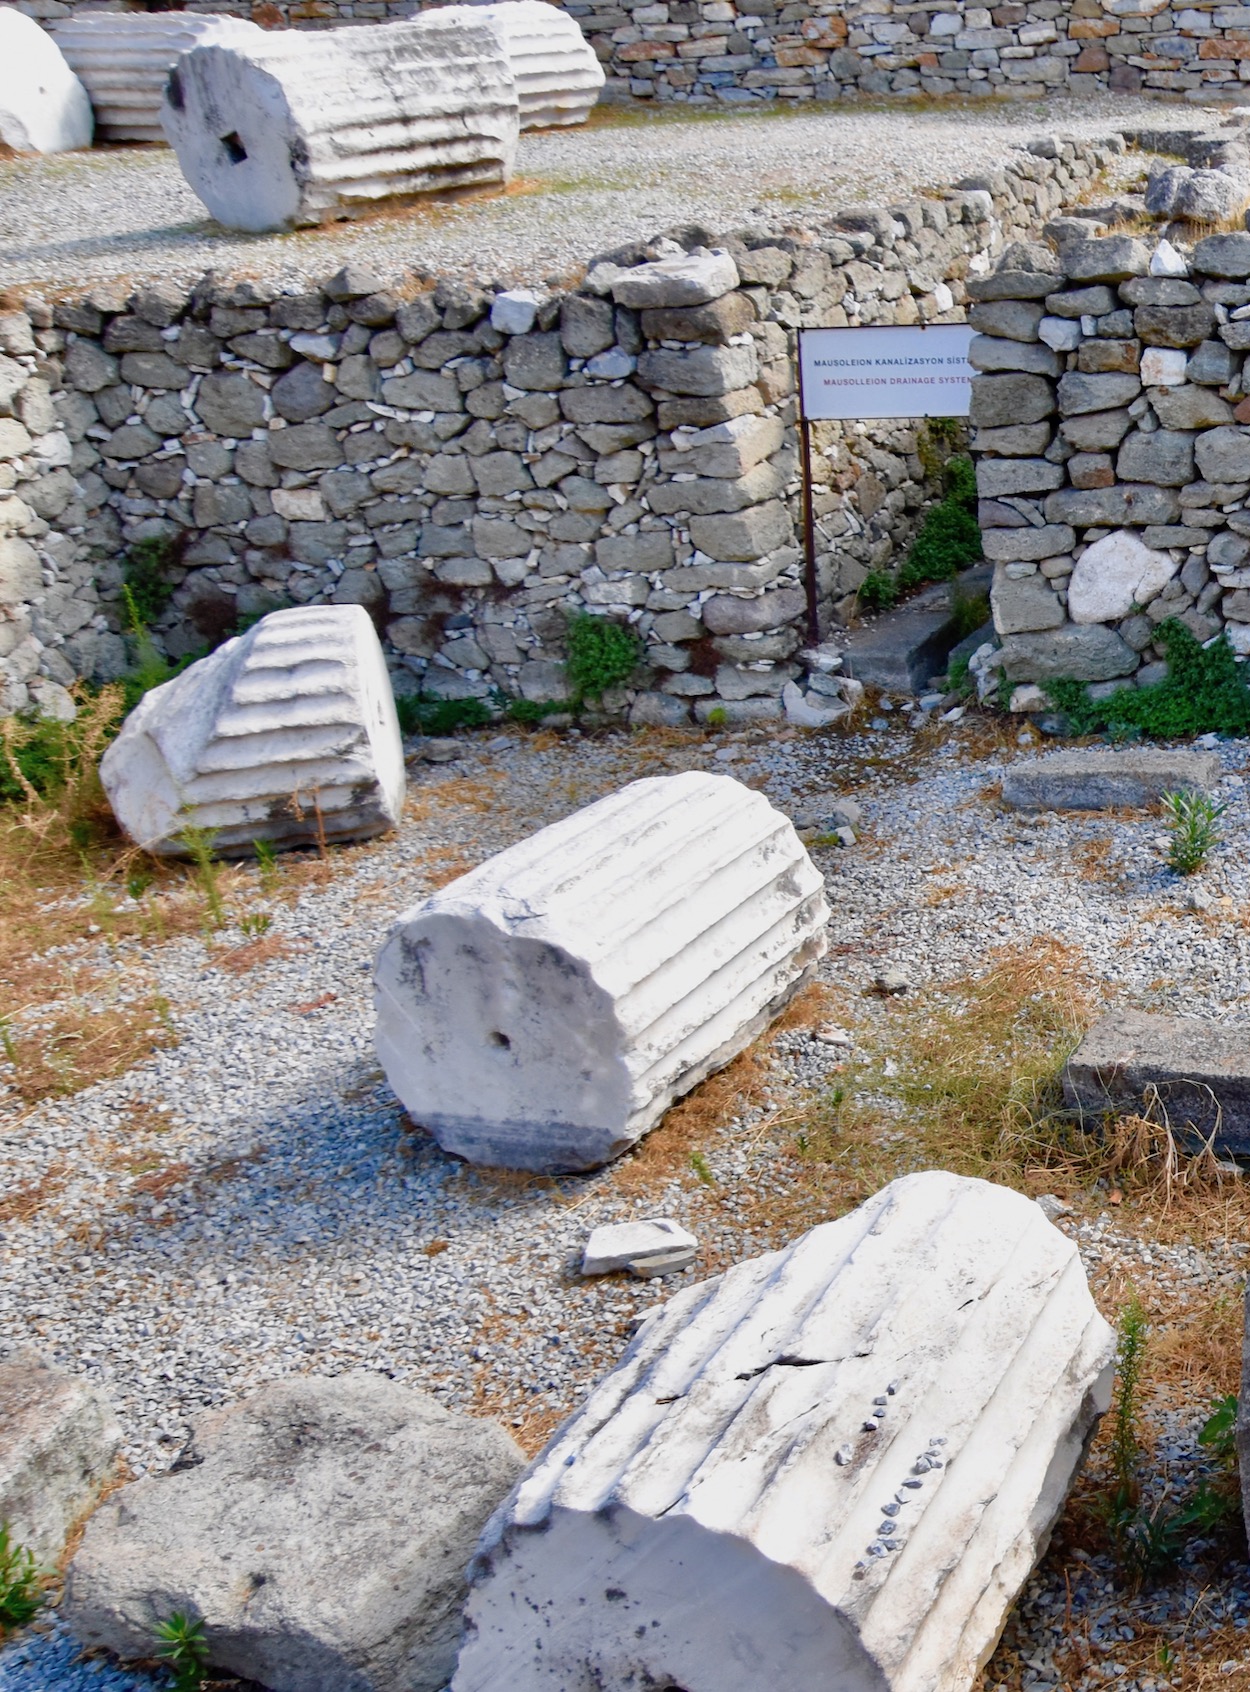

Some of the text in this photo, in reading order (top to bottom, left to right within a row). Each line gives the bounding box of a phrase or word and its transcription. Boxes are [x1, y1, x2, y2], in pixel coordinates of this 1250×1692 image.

[814, 355, 969, 367] MAUSOLEION KANALİZASYON SİST
[823, 378, 887, 386] MAUSOLLEION
[890, 377, 935, 385] DRAINAGE
